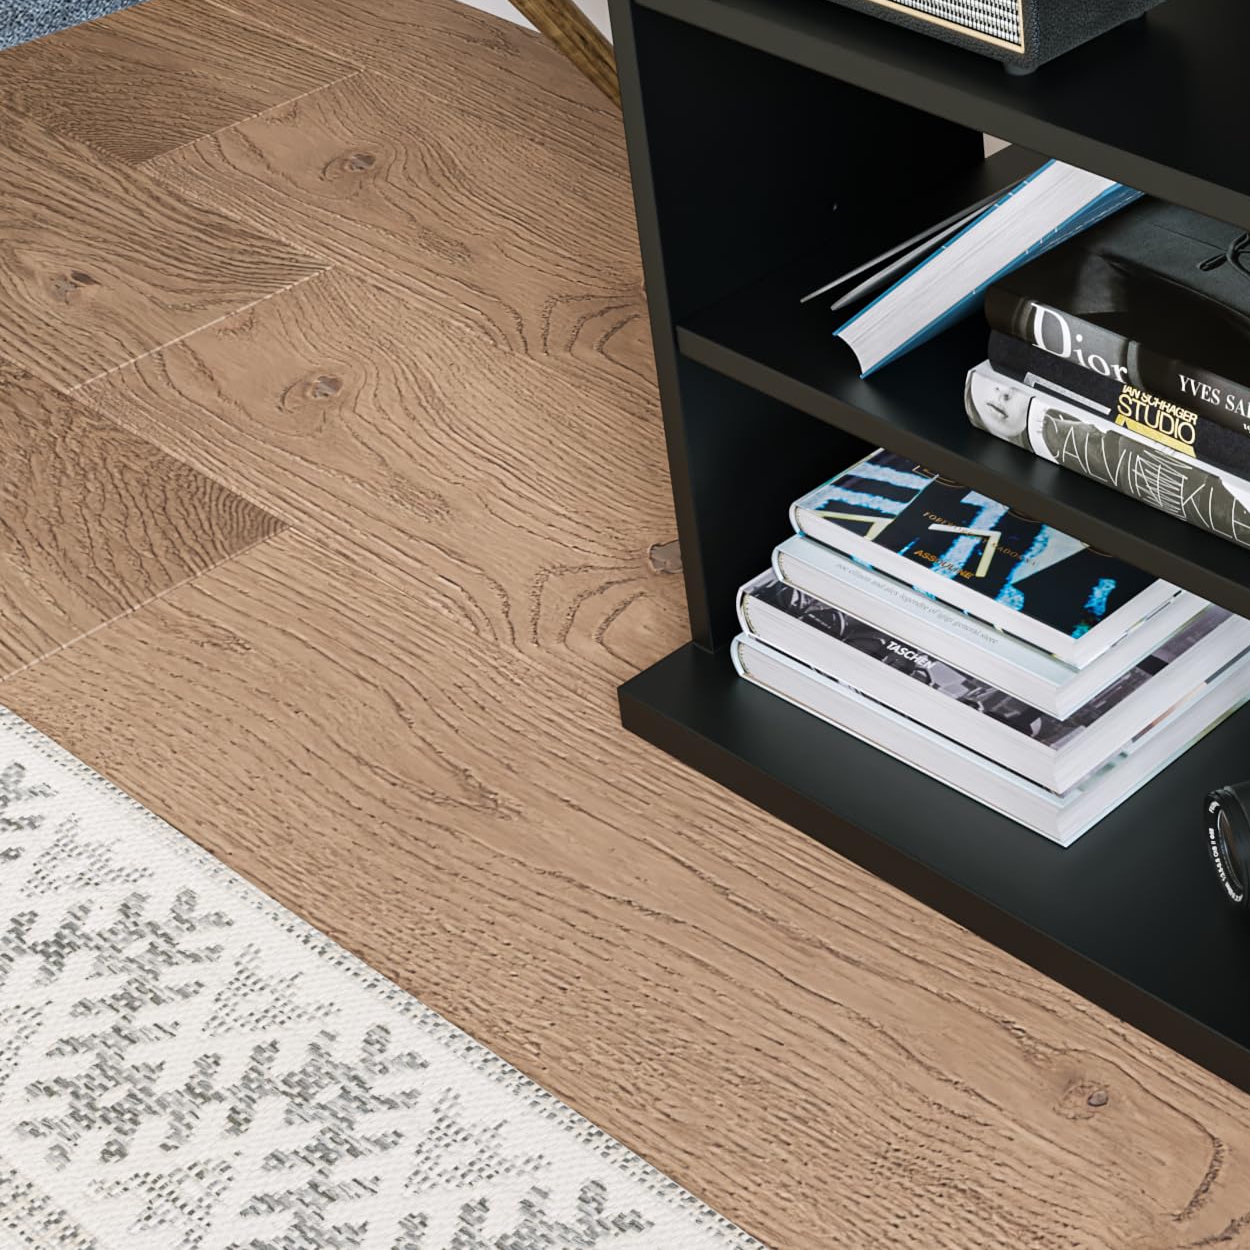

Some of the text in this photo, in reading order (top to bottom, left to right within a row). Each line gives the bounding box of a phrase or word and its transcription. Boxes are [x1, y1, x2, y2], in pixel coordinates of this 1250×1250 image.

[1030, 302, 1128, 385] Dior
[1122, 384, 1141, 399] IAN
[1178, 374, 1221, 406] YVES
[1116, 393, 1197, 445] STUDIO
[913, 549, 975, 580] ASSOULINE
[886, 640, 938, 669] TASCHEN
